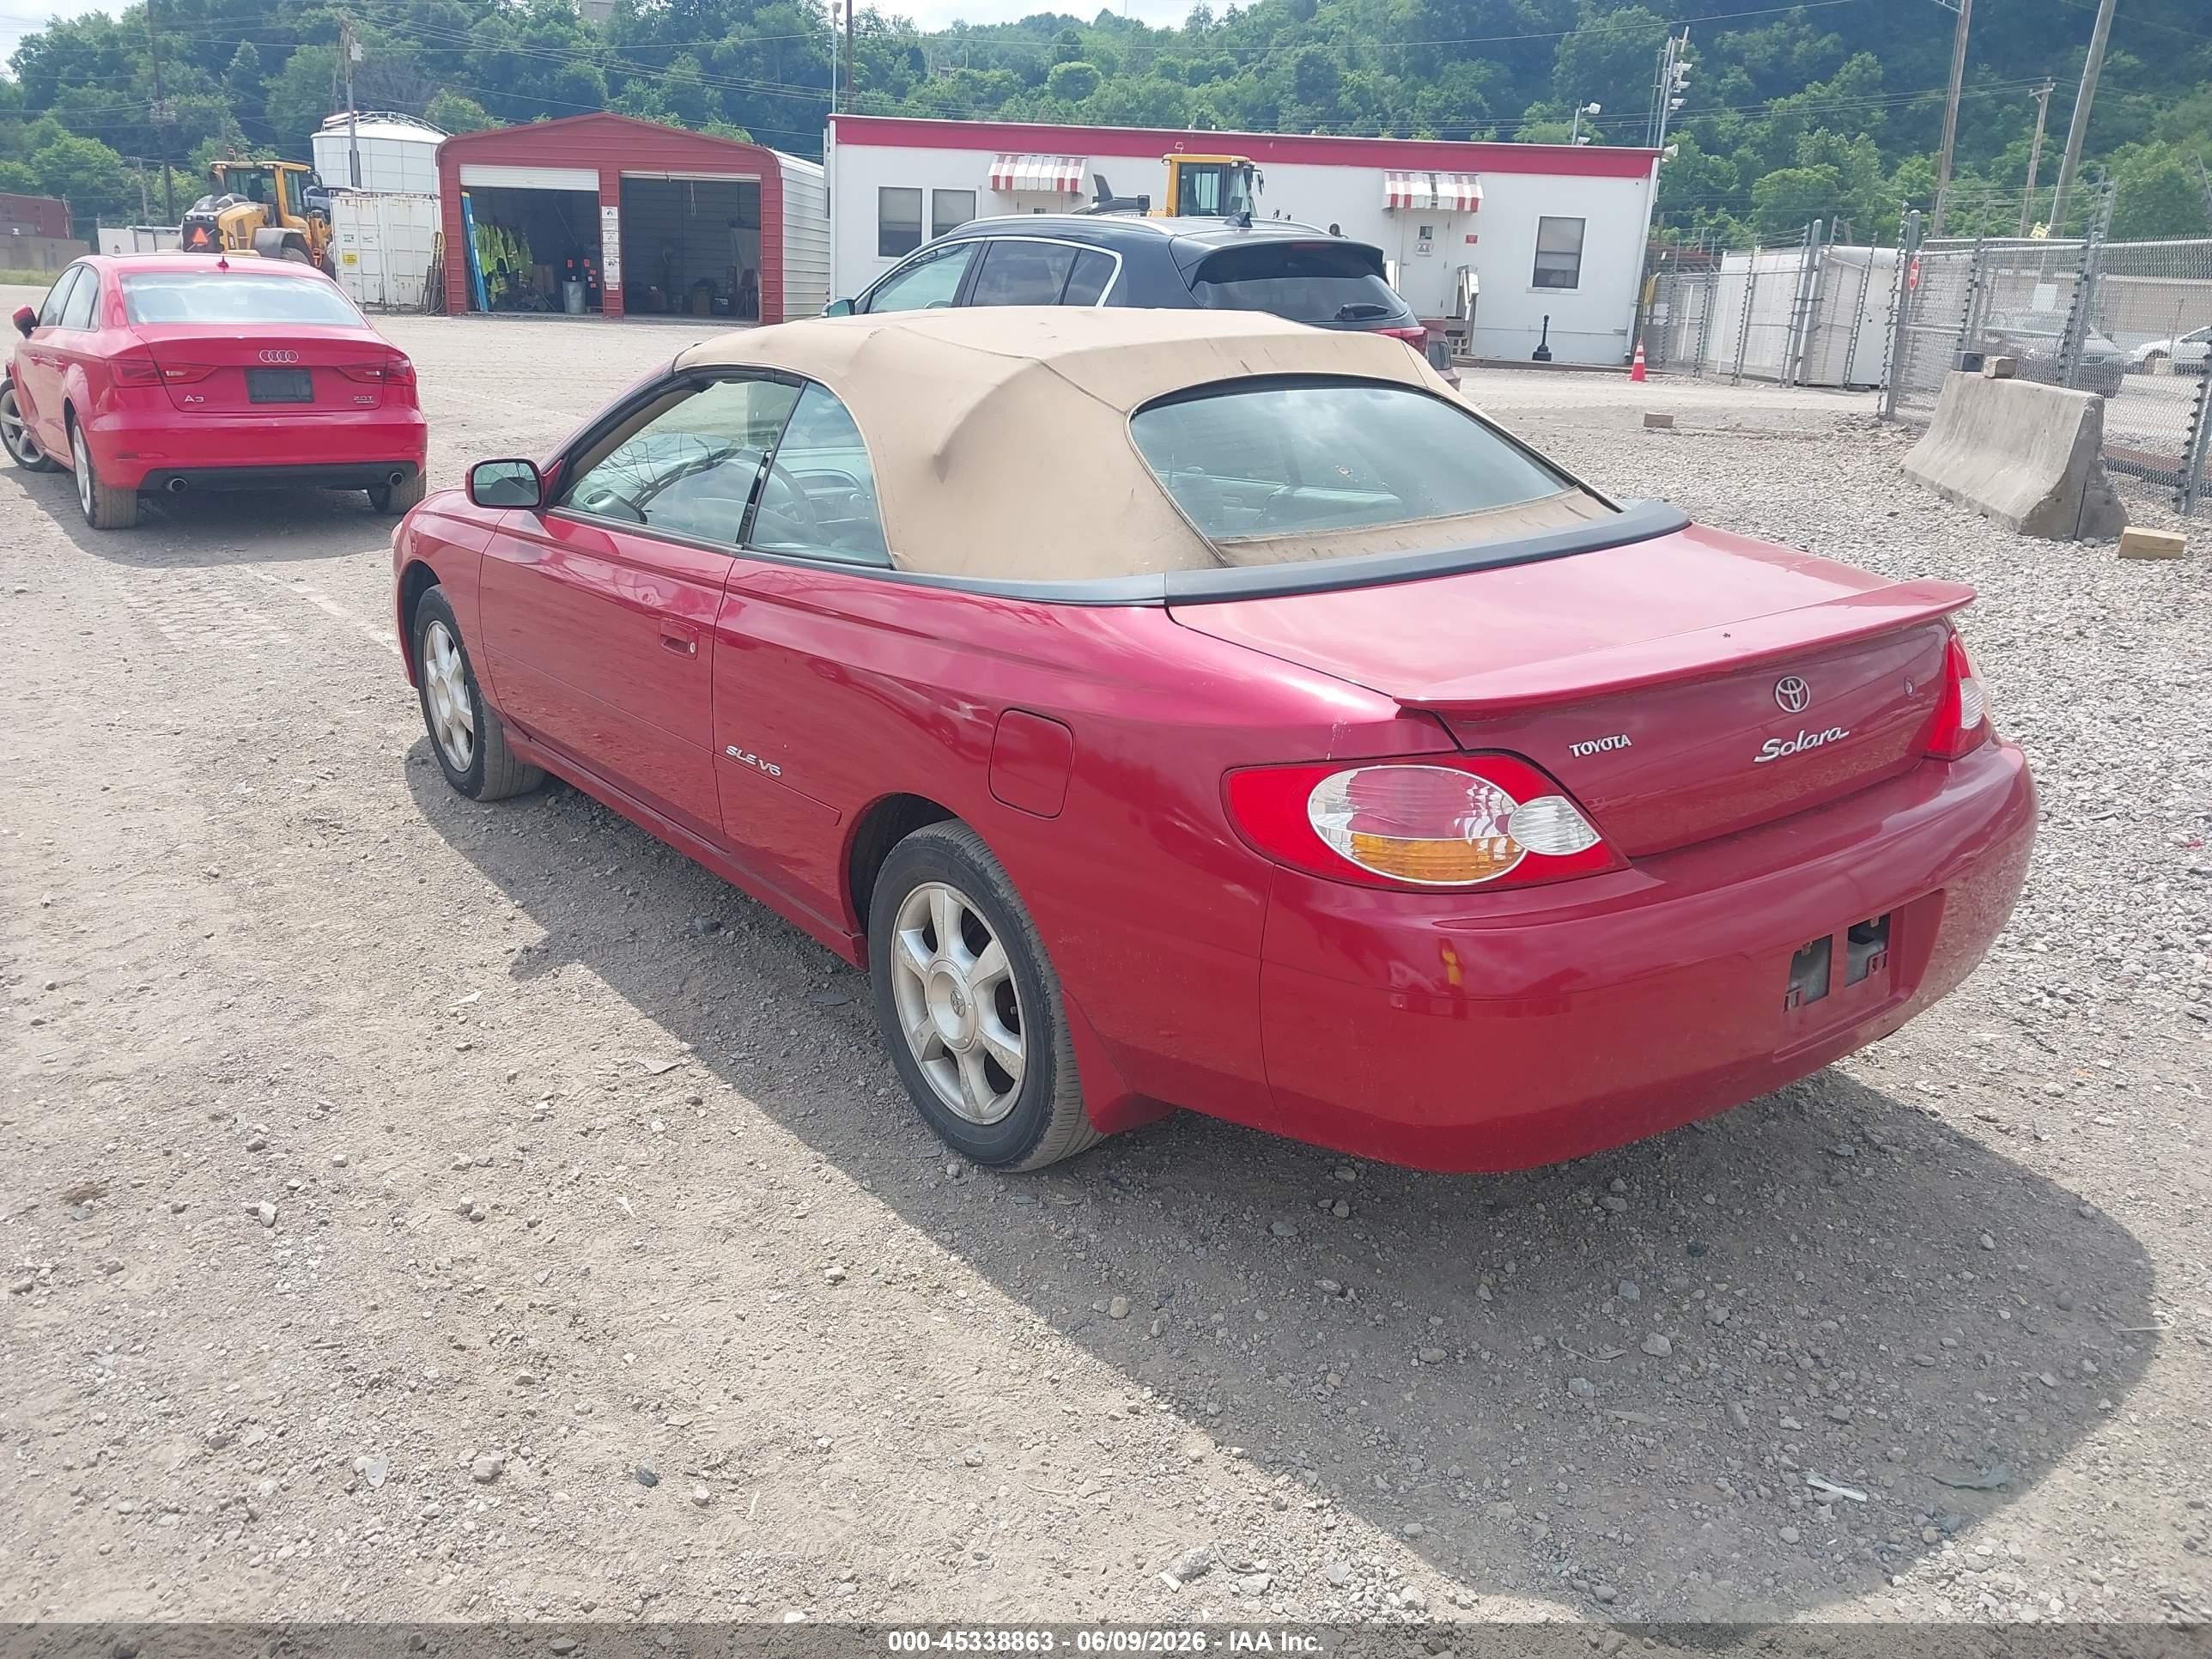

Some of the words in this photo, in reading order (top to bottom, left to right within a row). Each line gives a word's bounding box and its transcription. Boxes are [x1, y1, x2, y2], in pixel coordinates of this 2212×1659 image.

[184, 394, 204, 403] A3
[1569, 734, 1632, 757] TOYOTA
[1753, 726, 1850, 763] Solara
[726, 745, 757, 766] SLE
[758, 759, 781, 776] V6
